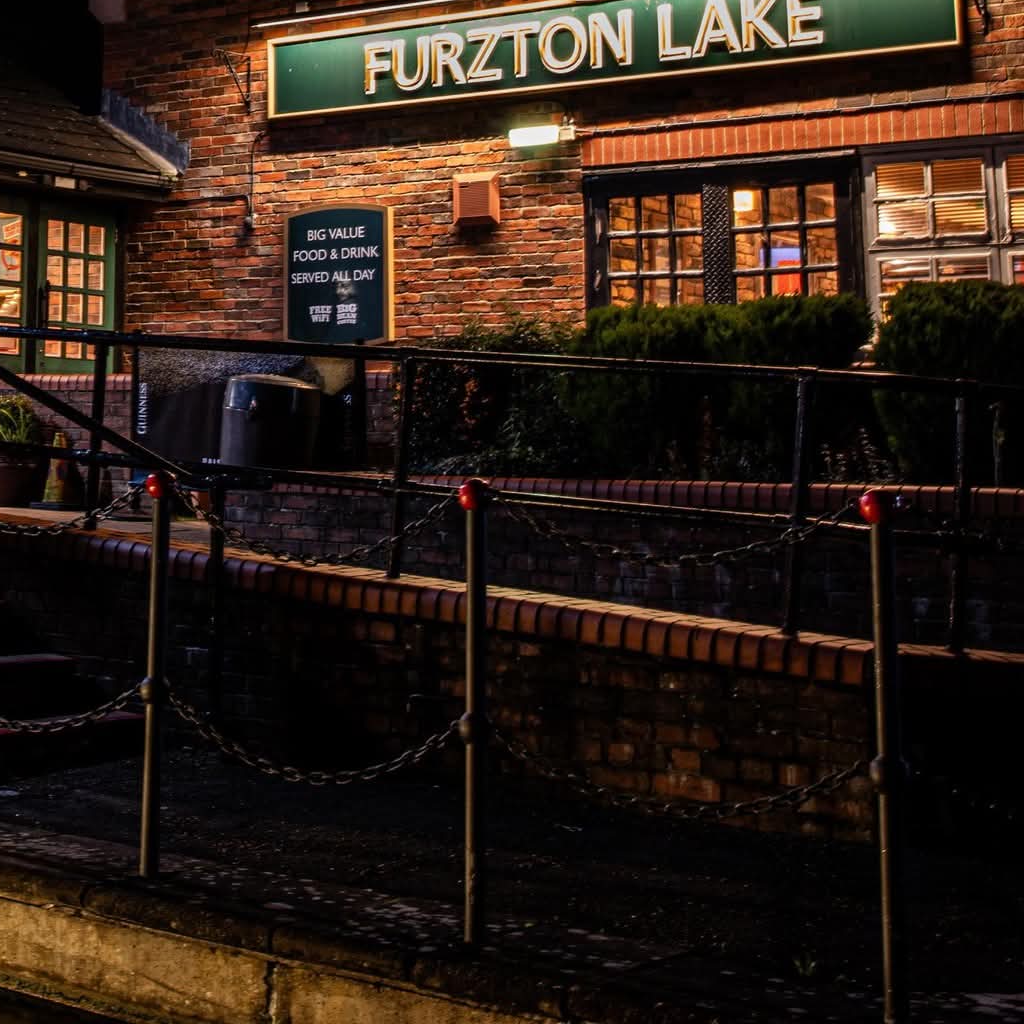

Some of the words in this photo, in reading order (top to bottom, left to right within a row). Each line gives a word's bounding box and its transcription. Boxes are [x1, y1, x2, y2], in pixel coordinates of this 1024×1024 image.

[364, 7, 635, 95] FURZTON
[307, 229, 326, 242] BIG
[328, 226, 366, 240] VALUE
[293, 248, 327, 262] FOOD
[329, 248, 338, 260] &
[341, 245, 379, 259] DRINK
[291, 271, 329, 284] SERVED
[331, 270, 351, 282] ALL
[353, 269, 376, 281] DAY
[309, 305, 332, 315] FREE
[336, 303, 358, 313] BIG
[136, 382, 149, 435] GUINNESS
